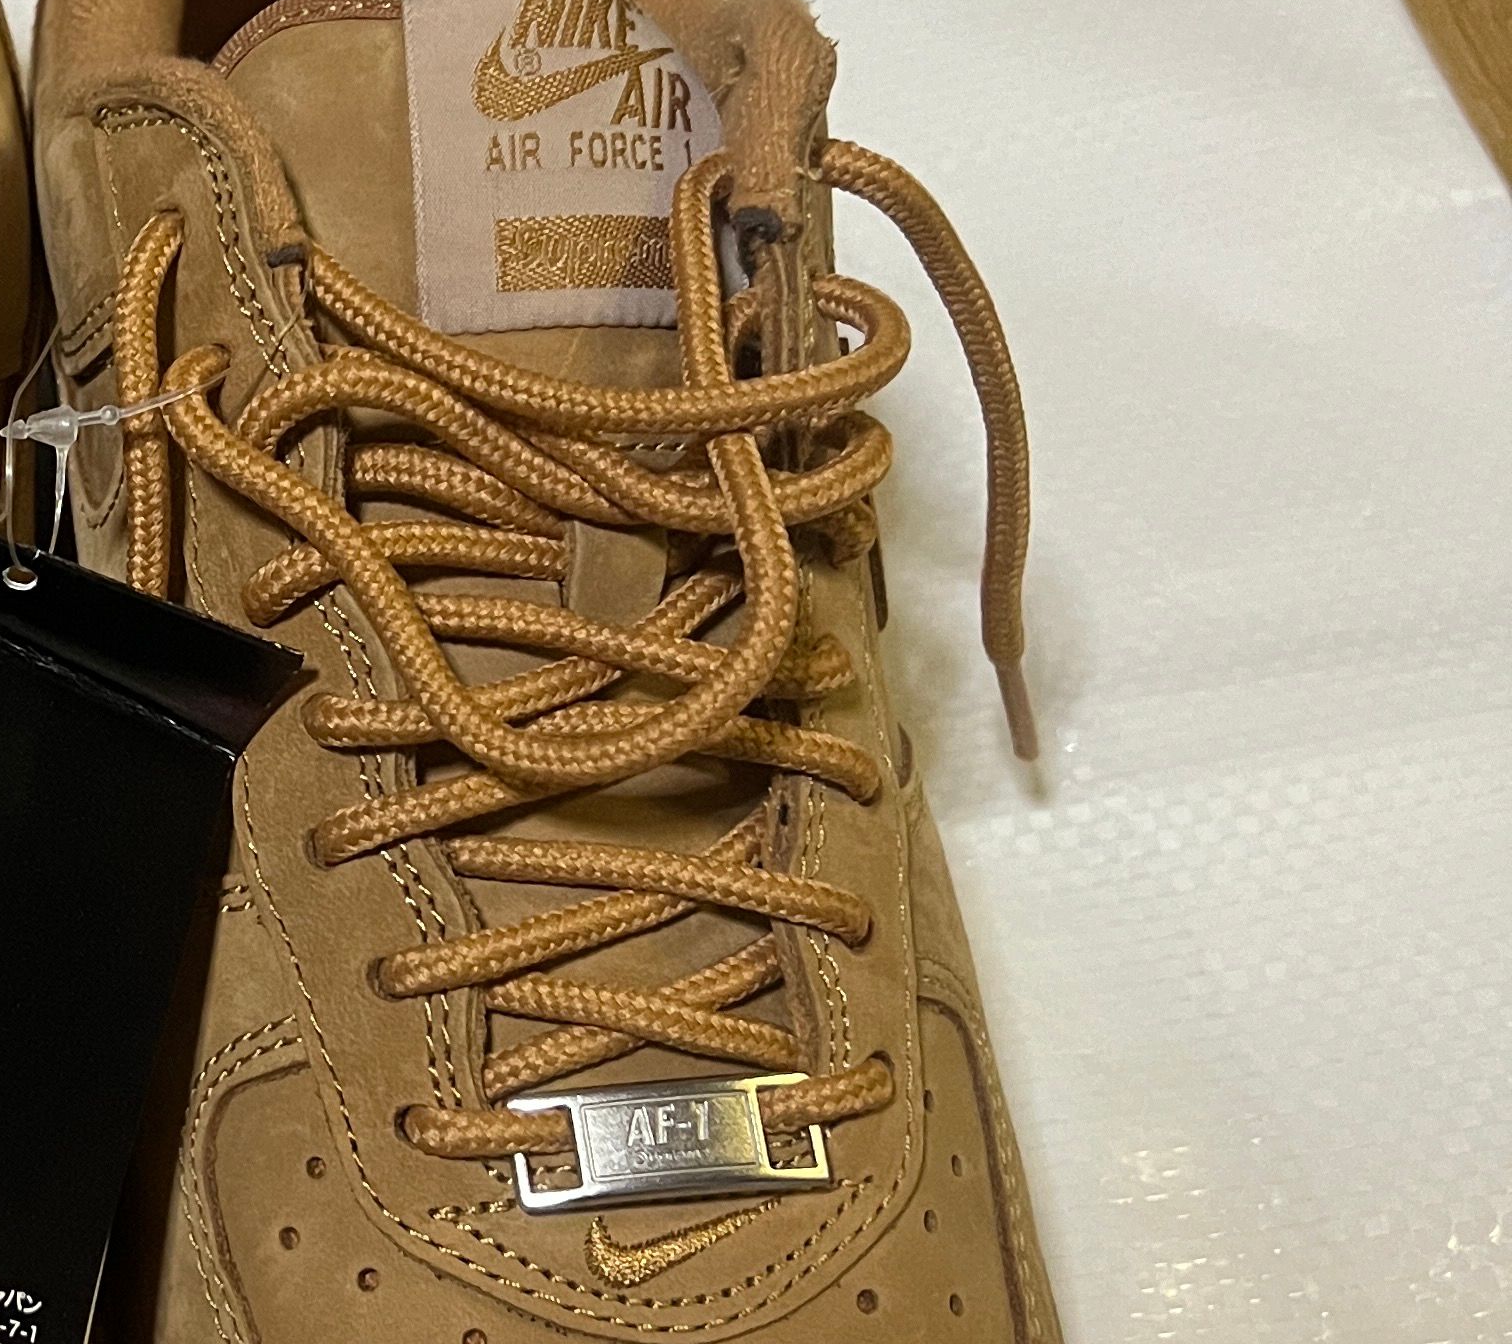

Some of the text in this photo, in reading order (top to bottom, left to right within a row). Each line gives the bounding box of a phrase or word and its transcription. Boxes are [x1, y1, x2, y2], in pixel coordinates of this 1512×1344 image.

[610, 63, 693, 133] AIR
[487, 130, 543, 172] AIR
[569, 129, 664, 172] FORCE
[627, 1099, 710, 1147] AF-1
